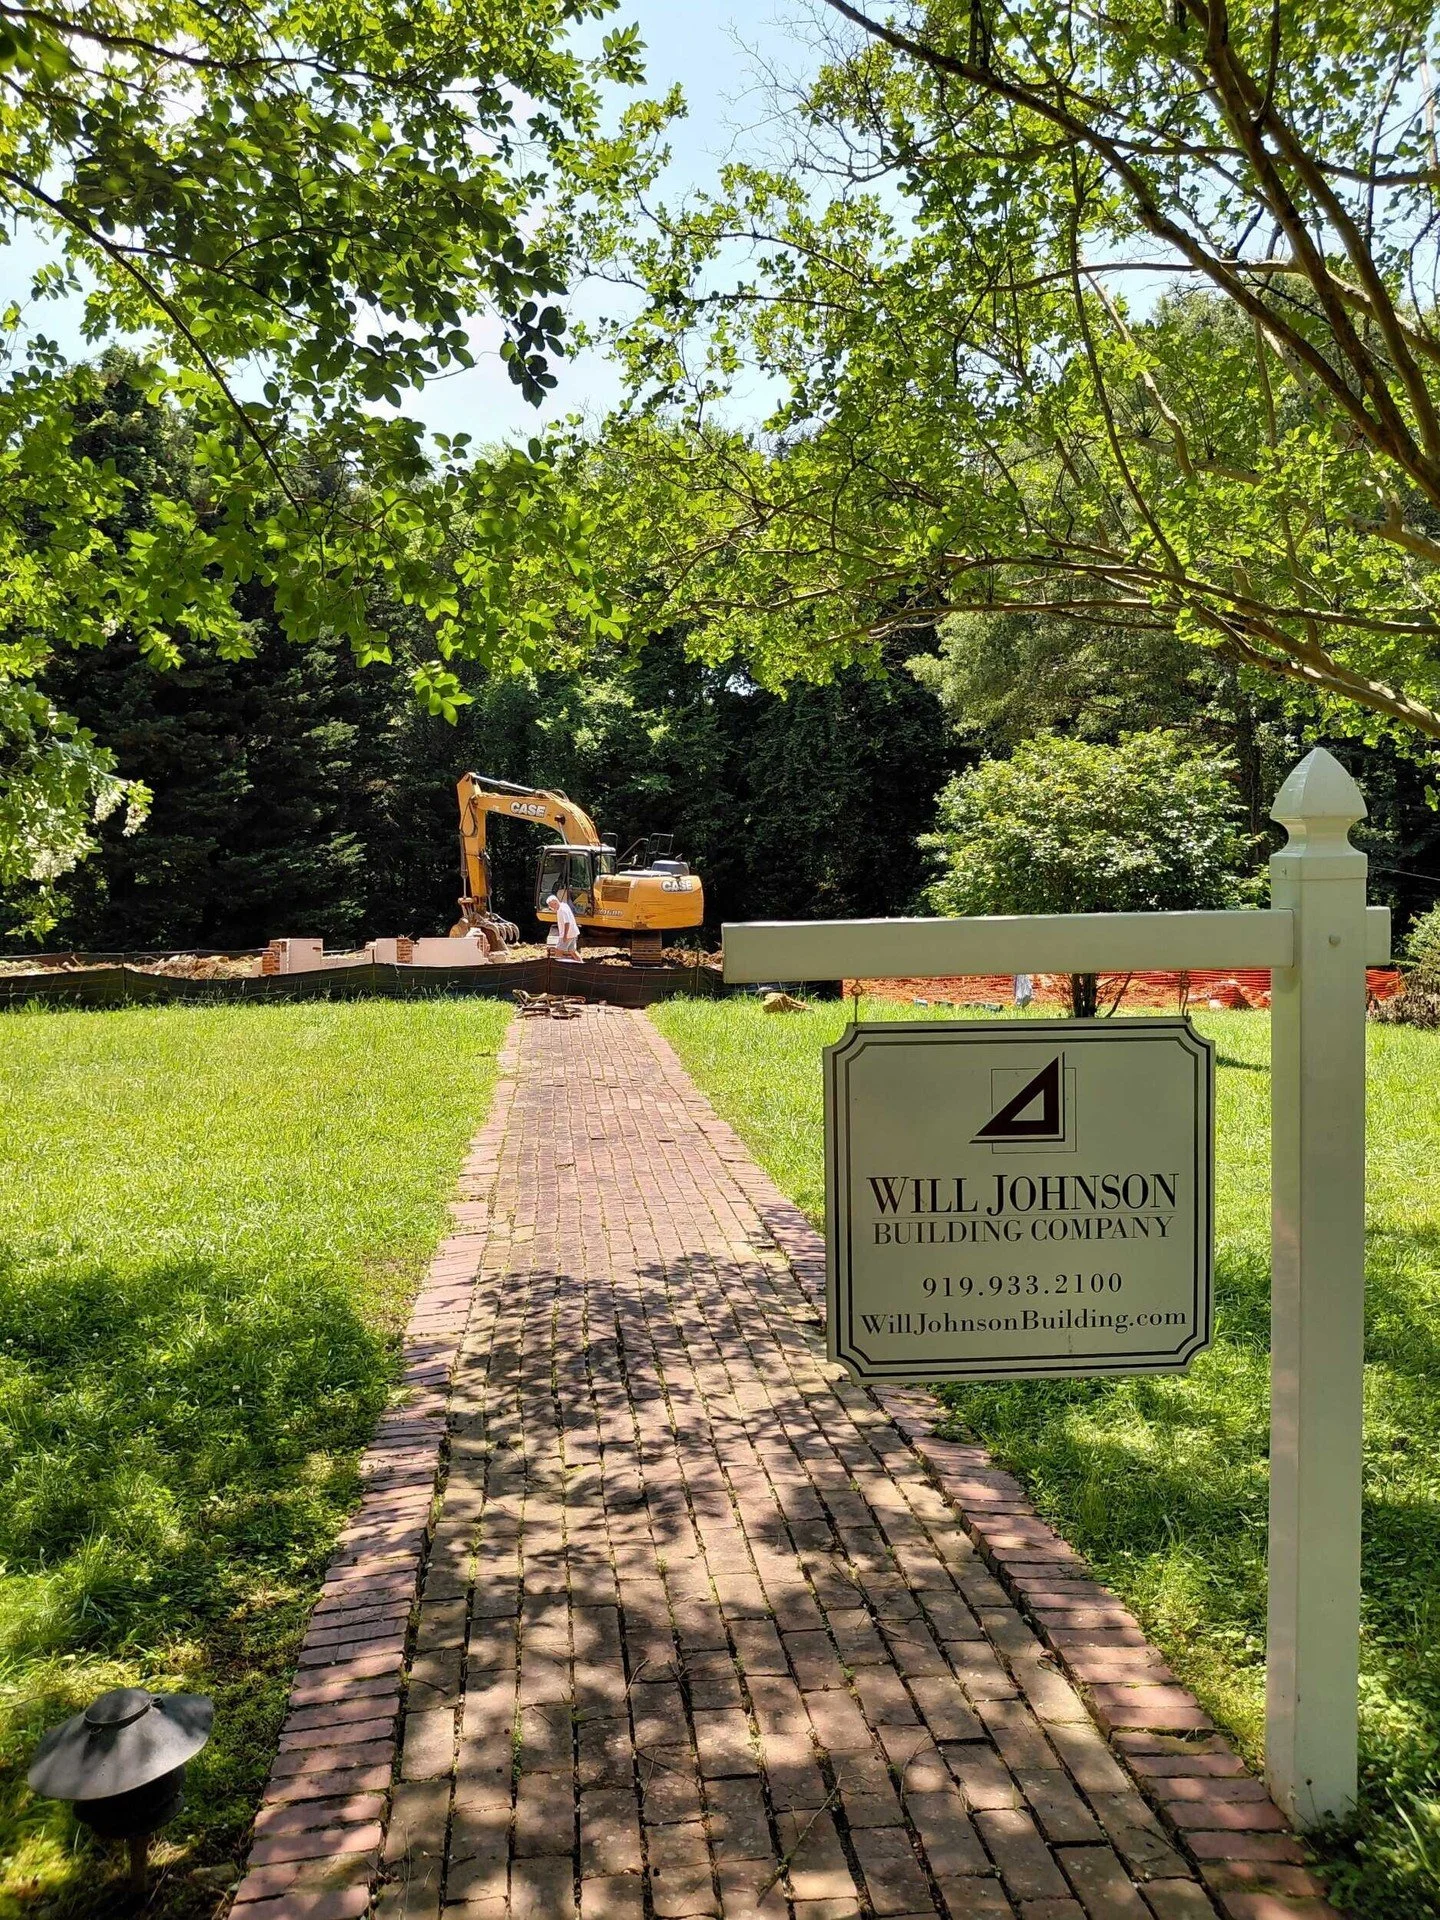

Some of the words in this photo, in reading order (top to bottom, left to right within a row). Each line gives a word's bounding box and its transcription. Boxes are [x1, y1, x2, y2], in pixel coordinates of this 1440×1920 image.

[510, 801, 546, 818] CASE
[662, 879, 693, 892] CASE
[866, 1175, 978, 1215] WILL
[986, 1172, 1180, 1216] JOHNSON
[872, 1220, 1023, 1245] BUILDING
[1031, 1215, 1174, 1242] COMPANY
[922, 1272, 1123, 1298] 919.933.2100
[861, 1309, 1187, 1336] WillJohnsonBuilding.com
